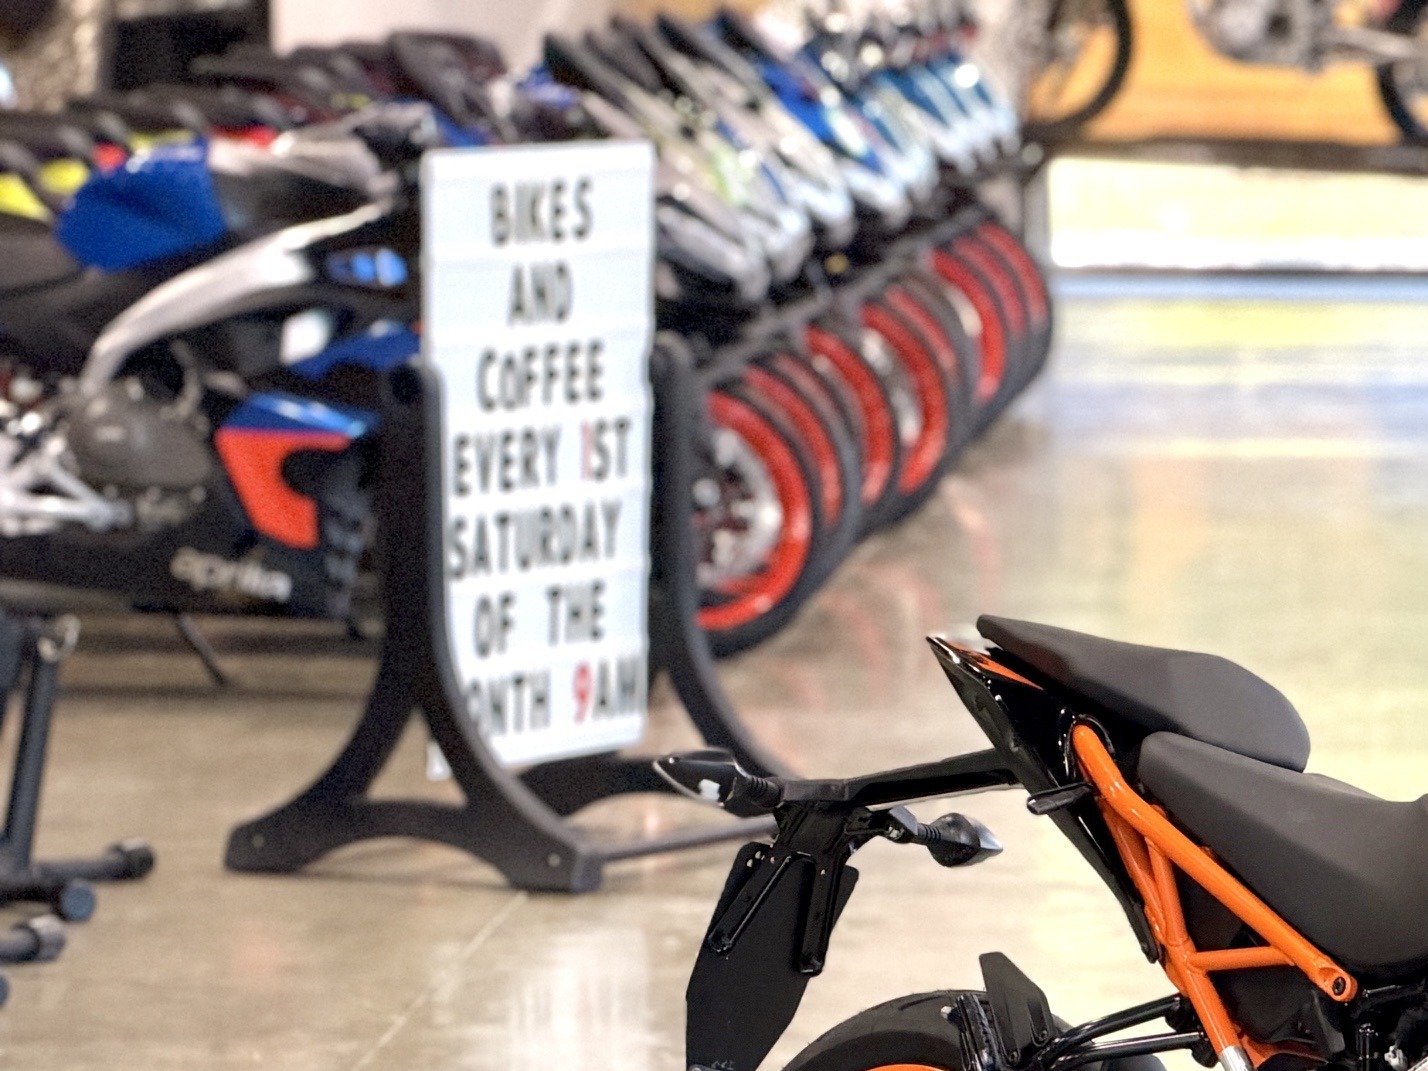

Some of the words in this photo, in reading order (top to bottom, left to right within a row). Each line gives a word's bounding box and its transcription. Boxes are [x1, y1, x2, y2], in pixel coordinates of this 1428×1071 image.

[490, 176, 594, 247] BIKES
[507, 260, 574, 326] AND
[476, 340, 604, 412] COFFEE
[454, 424, 562, 497] EVERY
[580, 416, 632, 482] 1ST
[445, 496, 624, 582] SATURDAY
[474, 590, 516, 660] OF
[546, 574, 607, 647] THE
[572, 655, 647, 725] 9AM
